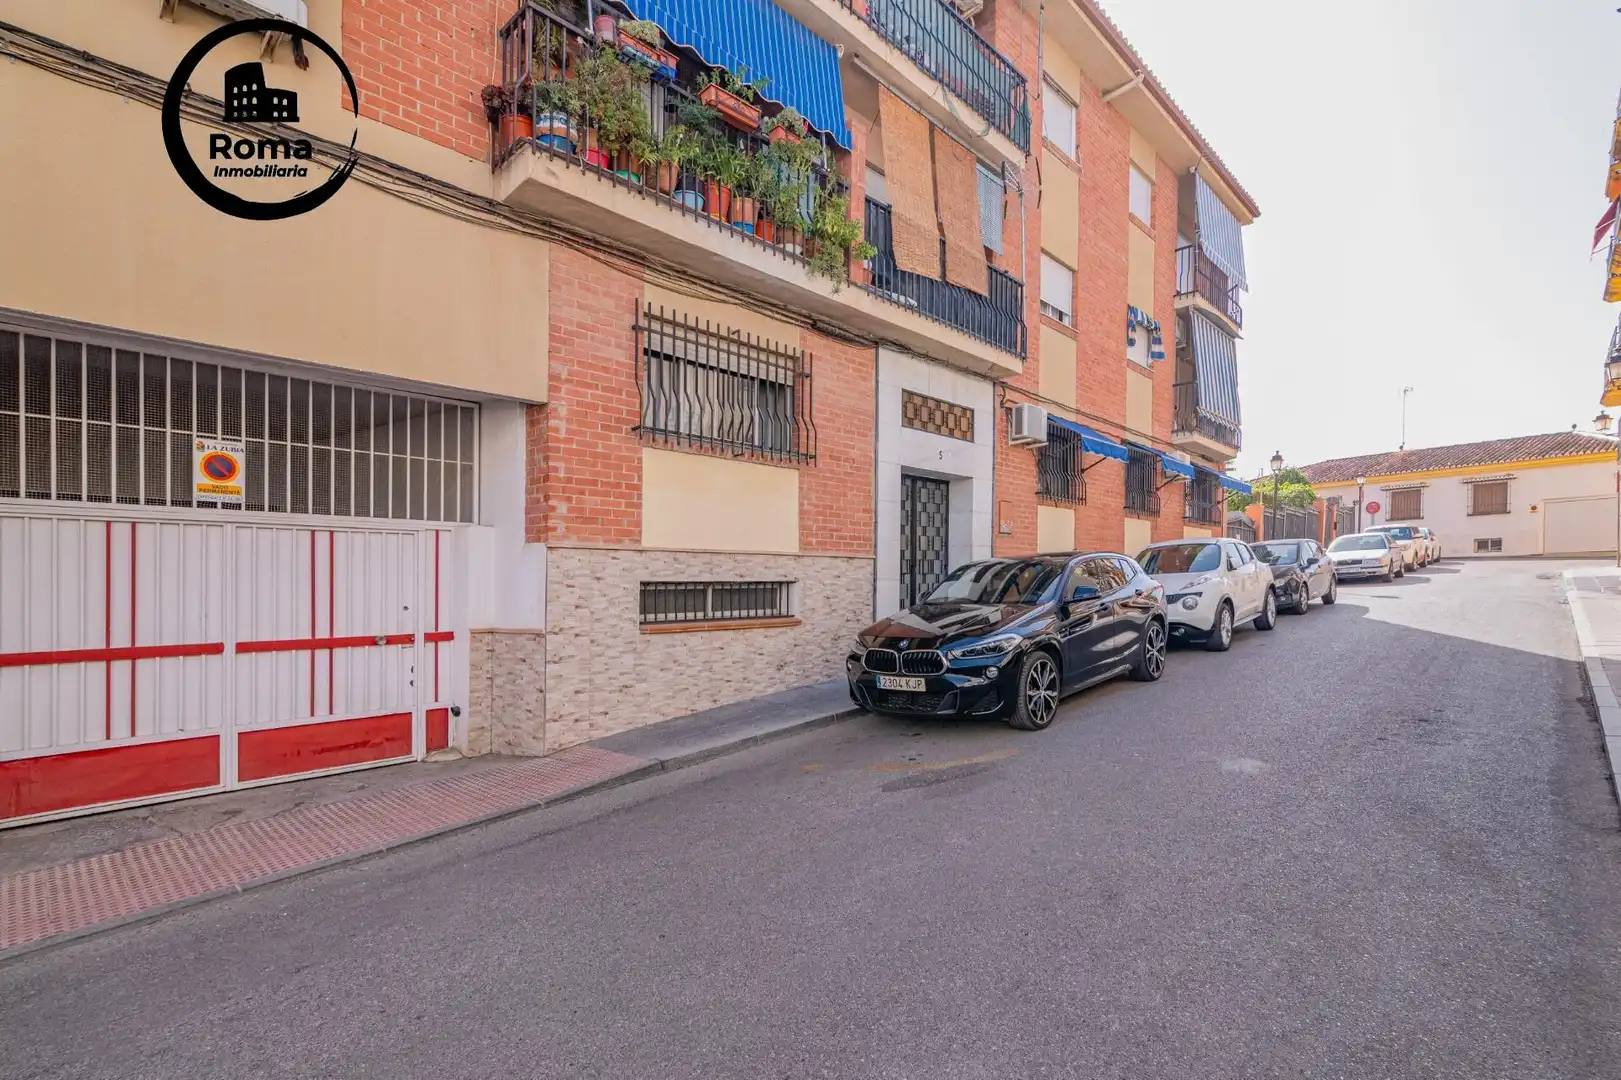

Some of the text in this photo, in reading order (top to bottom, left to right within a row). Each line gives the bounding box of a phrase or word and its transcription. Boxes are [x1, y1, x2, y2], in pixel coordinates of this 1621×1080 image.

[938, 450, 943, 460] 5
[198, 488, 241, 496] PERMANENTE
[882, 677, 922, 689] 2304 KJP
